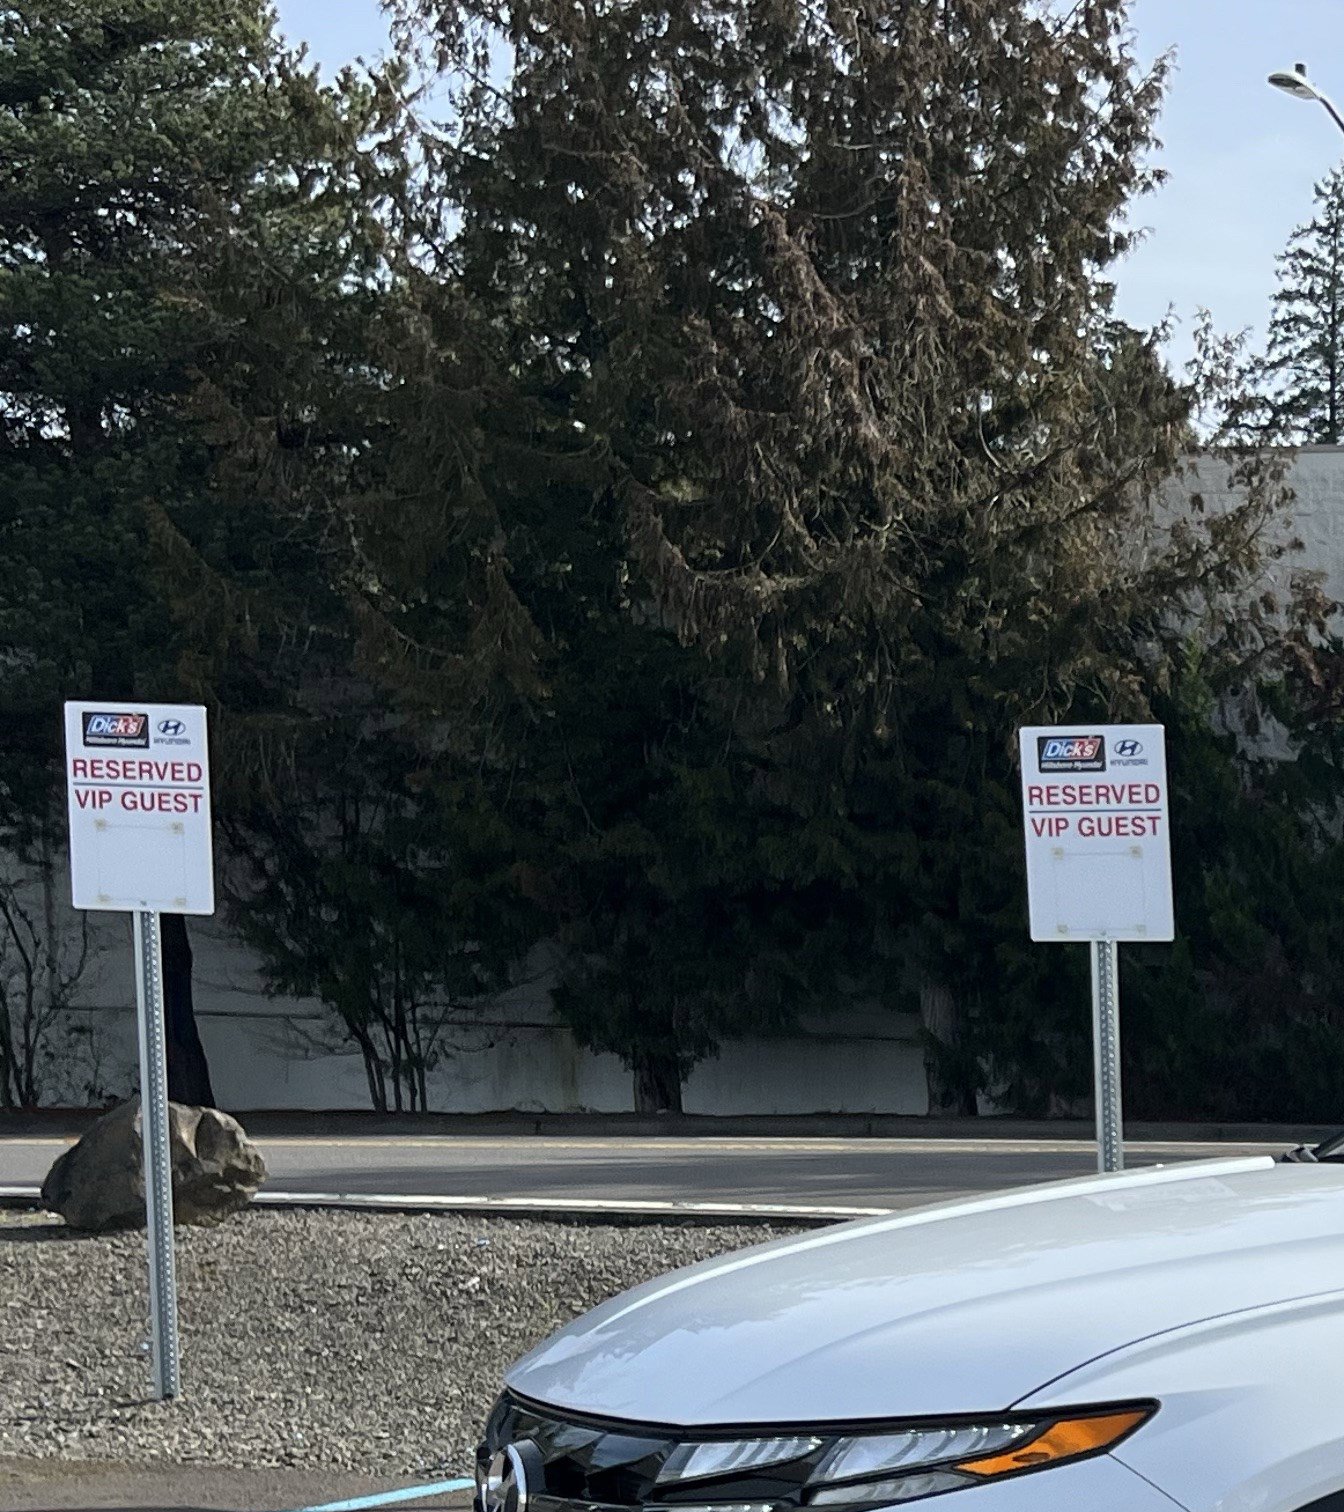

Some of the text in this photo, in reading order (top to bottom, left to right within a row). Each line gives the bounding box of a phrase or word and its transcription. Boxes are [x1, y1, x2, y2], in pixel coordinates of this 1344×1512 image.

[91, 716, 138, 735] Dick's
[1046, 740, 1095, 757] Dick's
[72, 758, 201, 783] RESERVED
[75, 789, 203, 814] VIP GUEST
[1028, 784, 1160, 806] RESERVED
[1031, 816, 1161, 837] VIP GUEST
